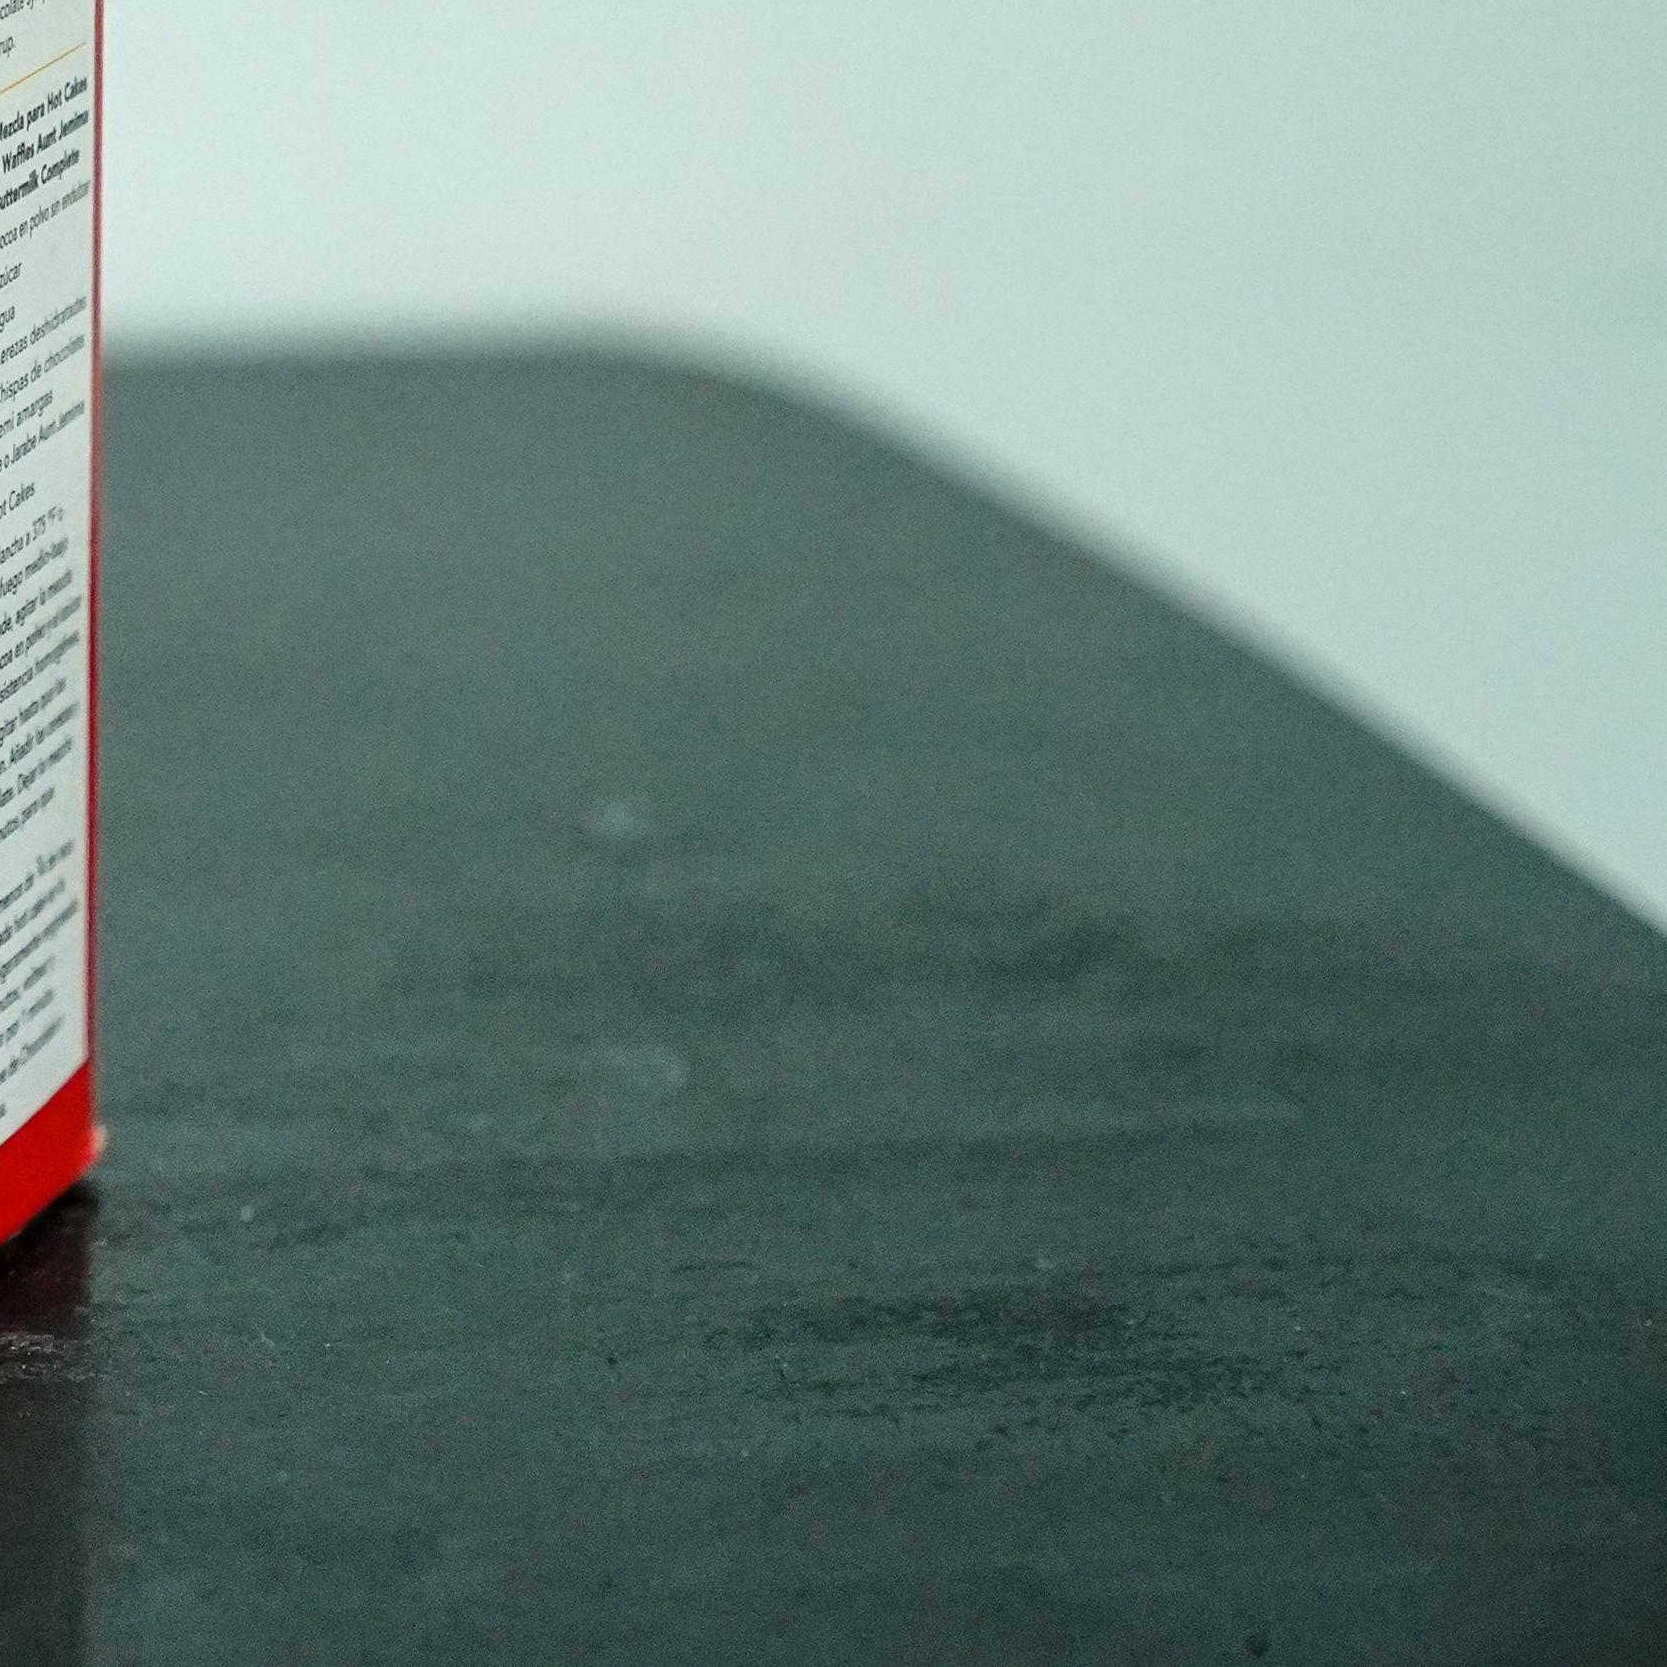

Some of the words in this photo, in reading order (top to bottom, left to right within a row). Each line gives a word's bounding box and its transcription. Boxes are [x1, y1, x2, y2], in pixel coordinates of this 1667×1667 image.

[27, 103, 45, 130] para
[47, 89, 62, 113] Hot
[64, 77, 87, 102] Cakes
[2, 142, 35, 174] Waffles
[37, 127, 57, 155] Aunt
[30, 365, 41, 383] de
[11, 432, 37, 464] Jarabe
[8, 482, 36, 512] Cakes
